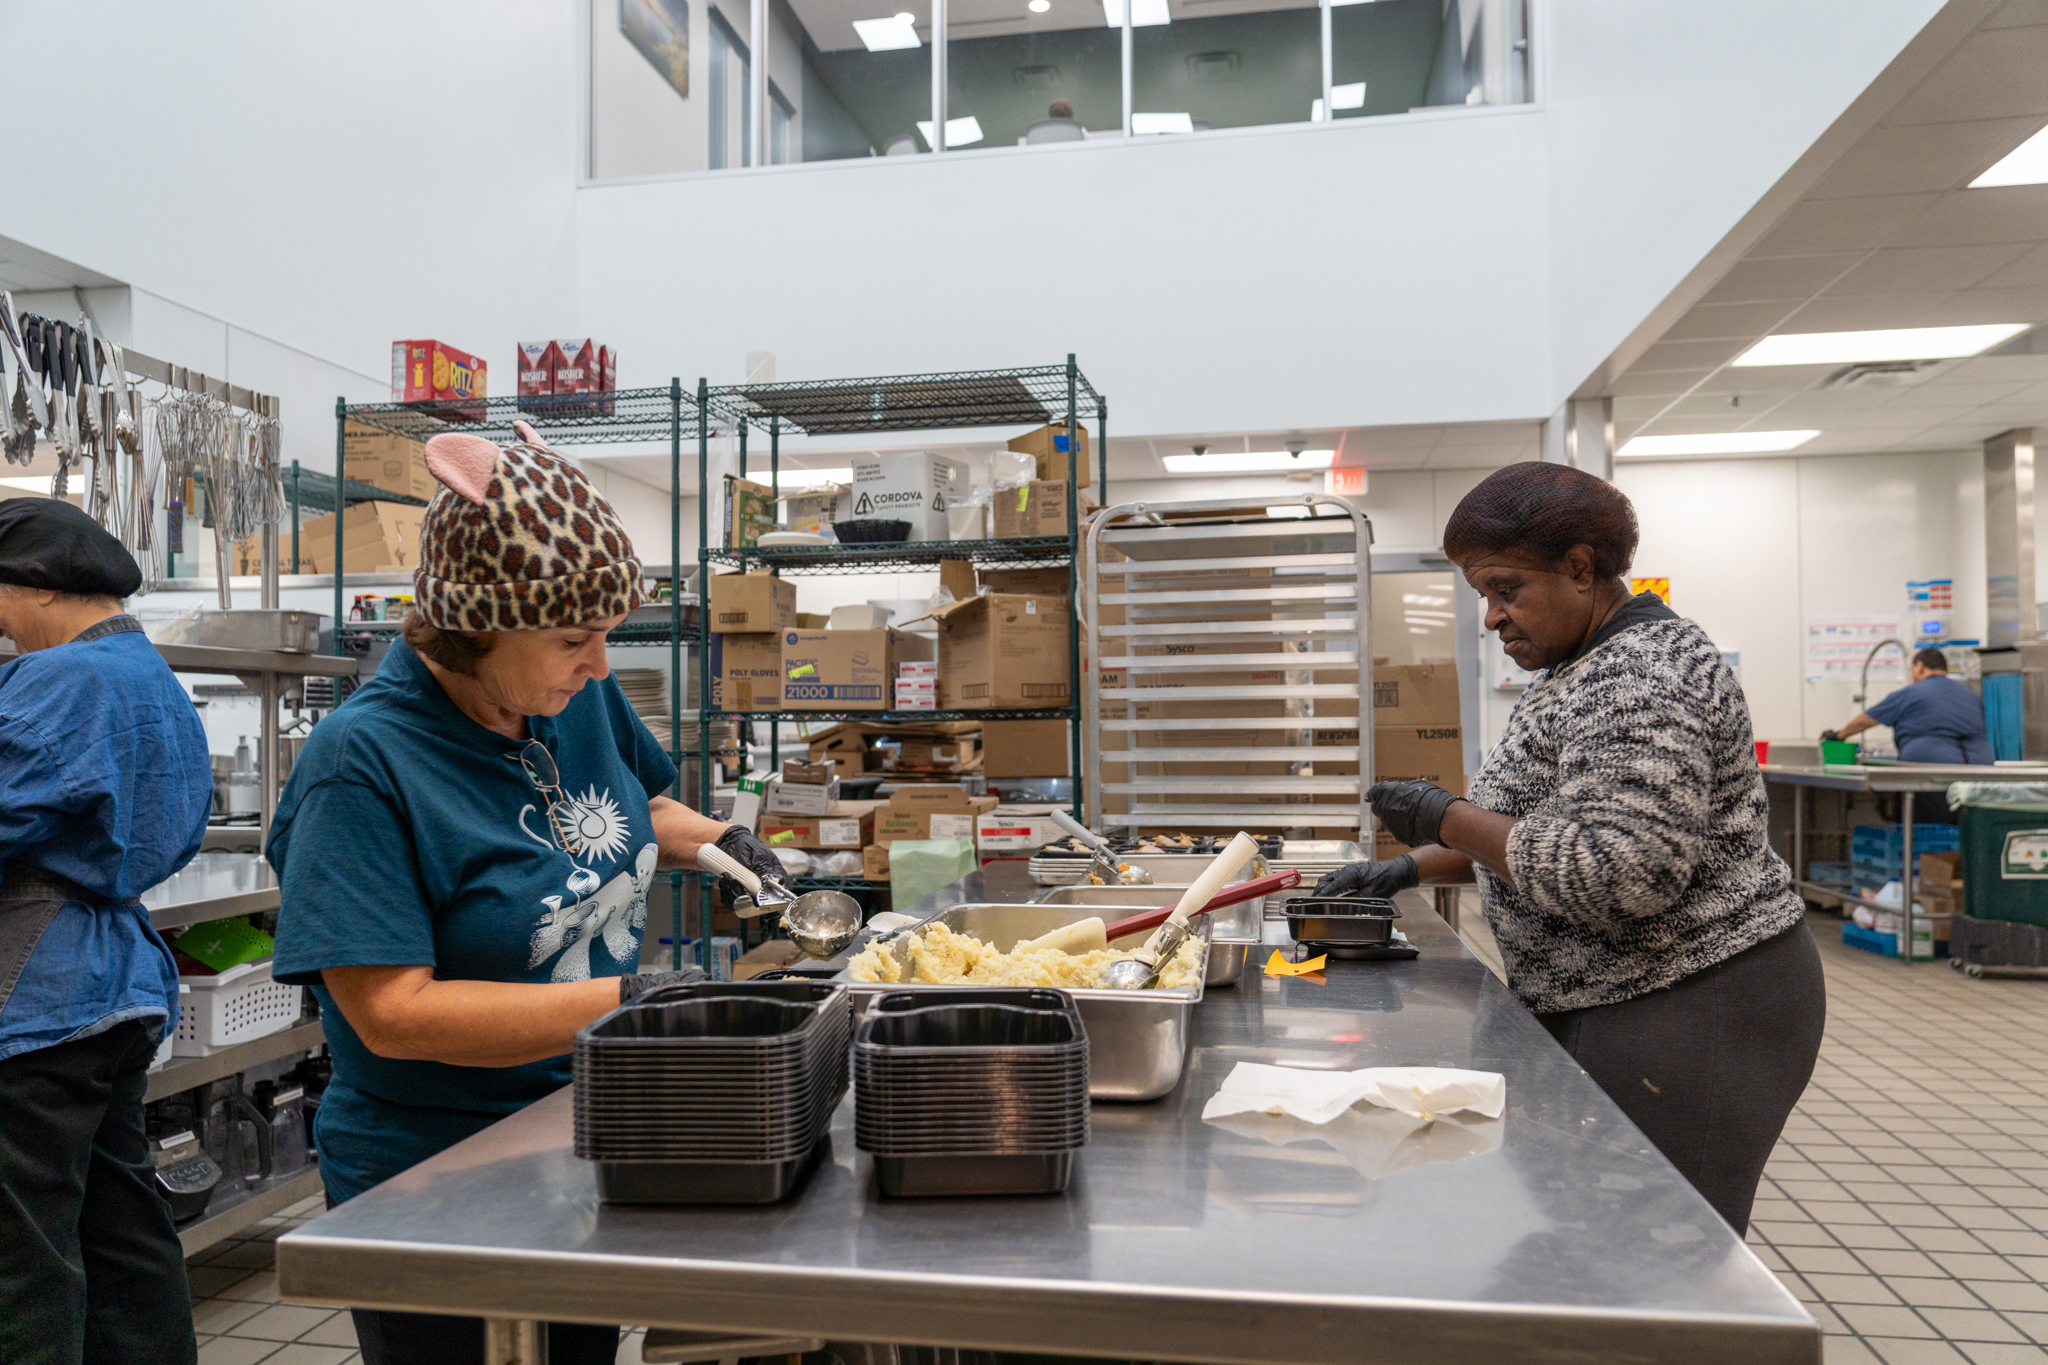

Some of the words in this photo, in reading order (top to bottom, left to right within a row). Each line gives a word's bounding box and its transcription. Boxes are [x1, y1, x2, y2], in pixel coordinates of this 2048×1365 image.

[450, 361, 473, 393] RITZ
[521, 370, 547, 382] KOSHER
[558, 368, 584, 380] KOSHER
[1332, 469, 1365, 494] EXIT
[873, 491, 923, 504] CORDOVA
[1166, 644, 1195, 655] Sysco
[785, 659, 819, 668] PACIFIC
[730, 669, 748, 677] POLY
[750, 669, 779, 677] GLOVES
[712, 675, 722, 706] POLY
[787, 686, 829, 698] 21000
[1416, 728, 1458, 740] YL2508
[885, 819, 918, 827] Reliance
